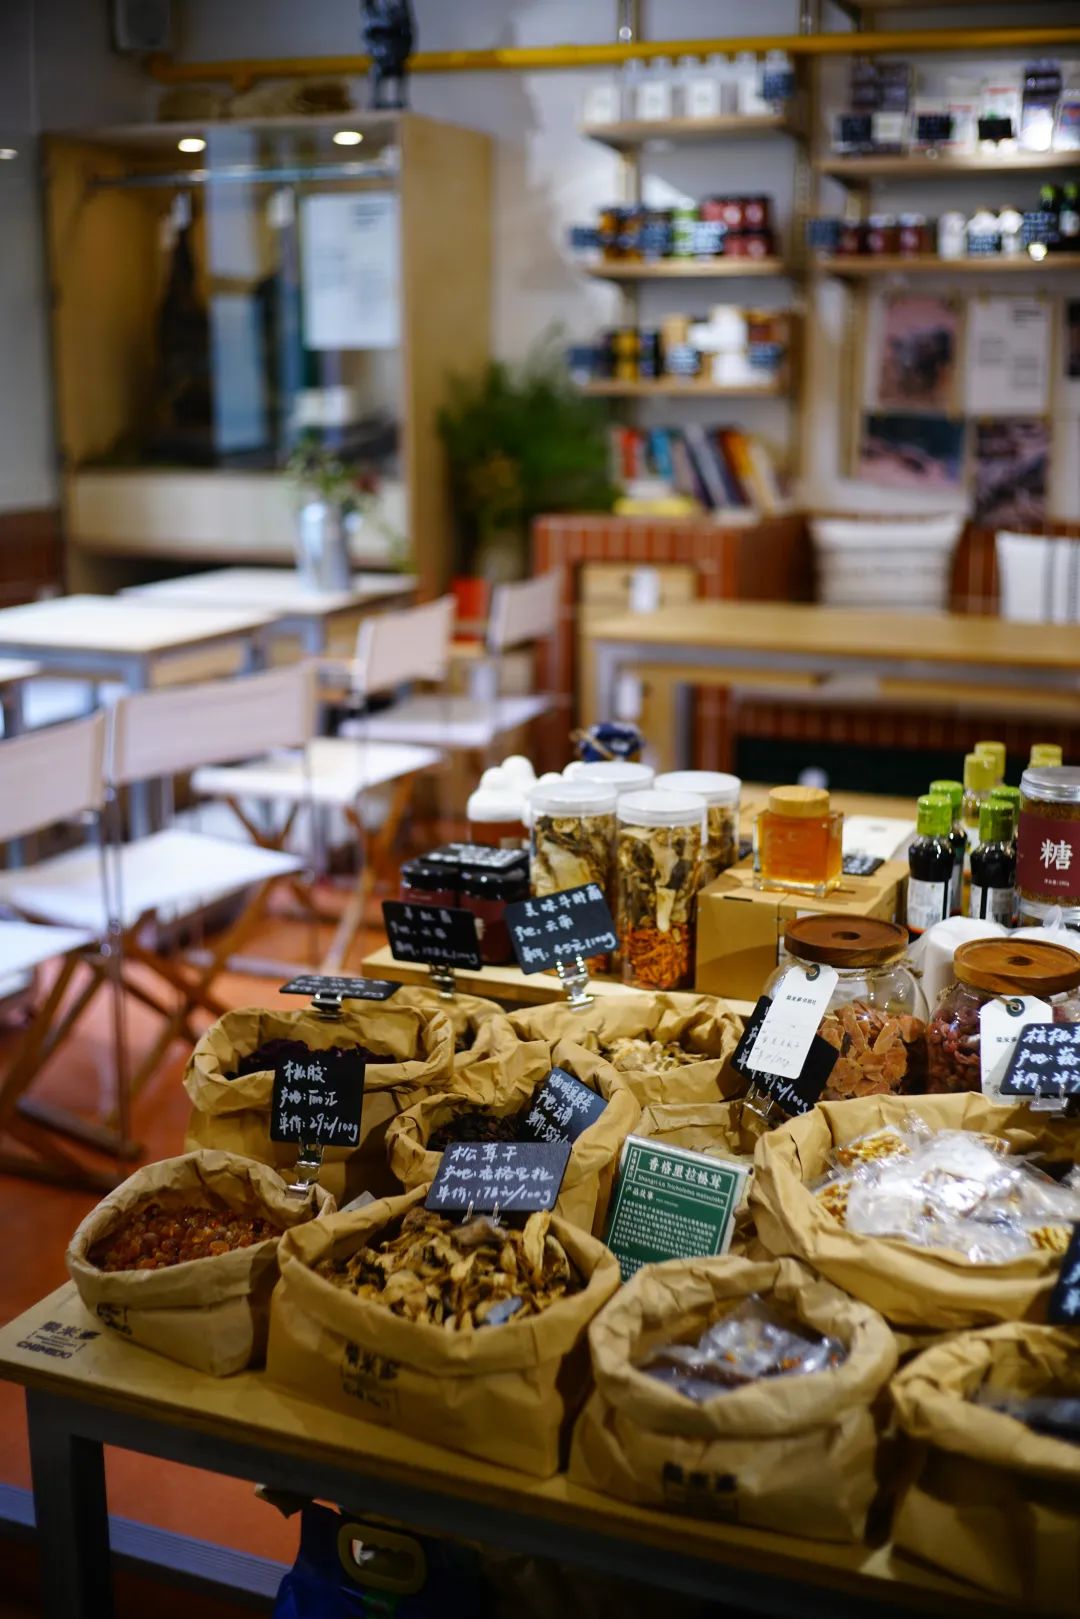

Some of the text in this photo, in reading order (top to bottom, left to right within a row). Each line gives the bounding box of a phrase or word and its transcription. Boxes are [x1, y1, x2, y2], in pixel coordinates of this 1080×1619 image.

[1040, 838, 1073, 870] 糖
[283, 1060, 328, 1083] 桃胶
[450, 1143, 517, 1162] 松茸干
